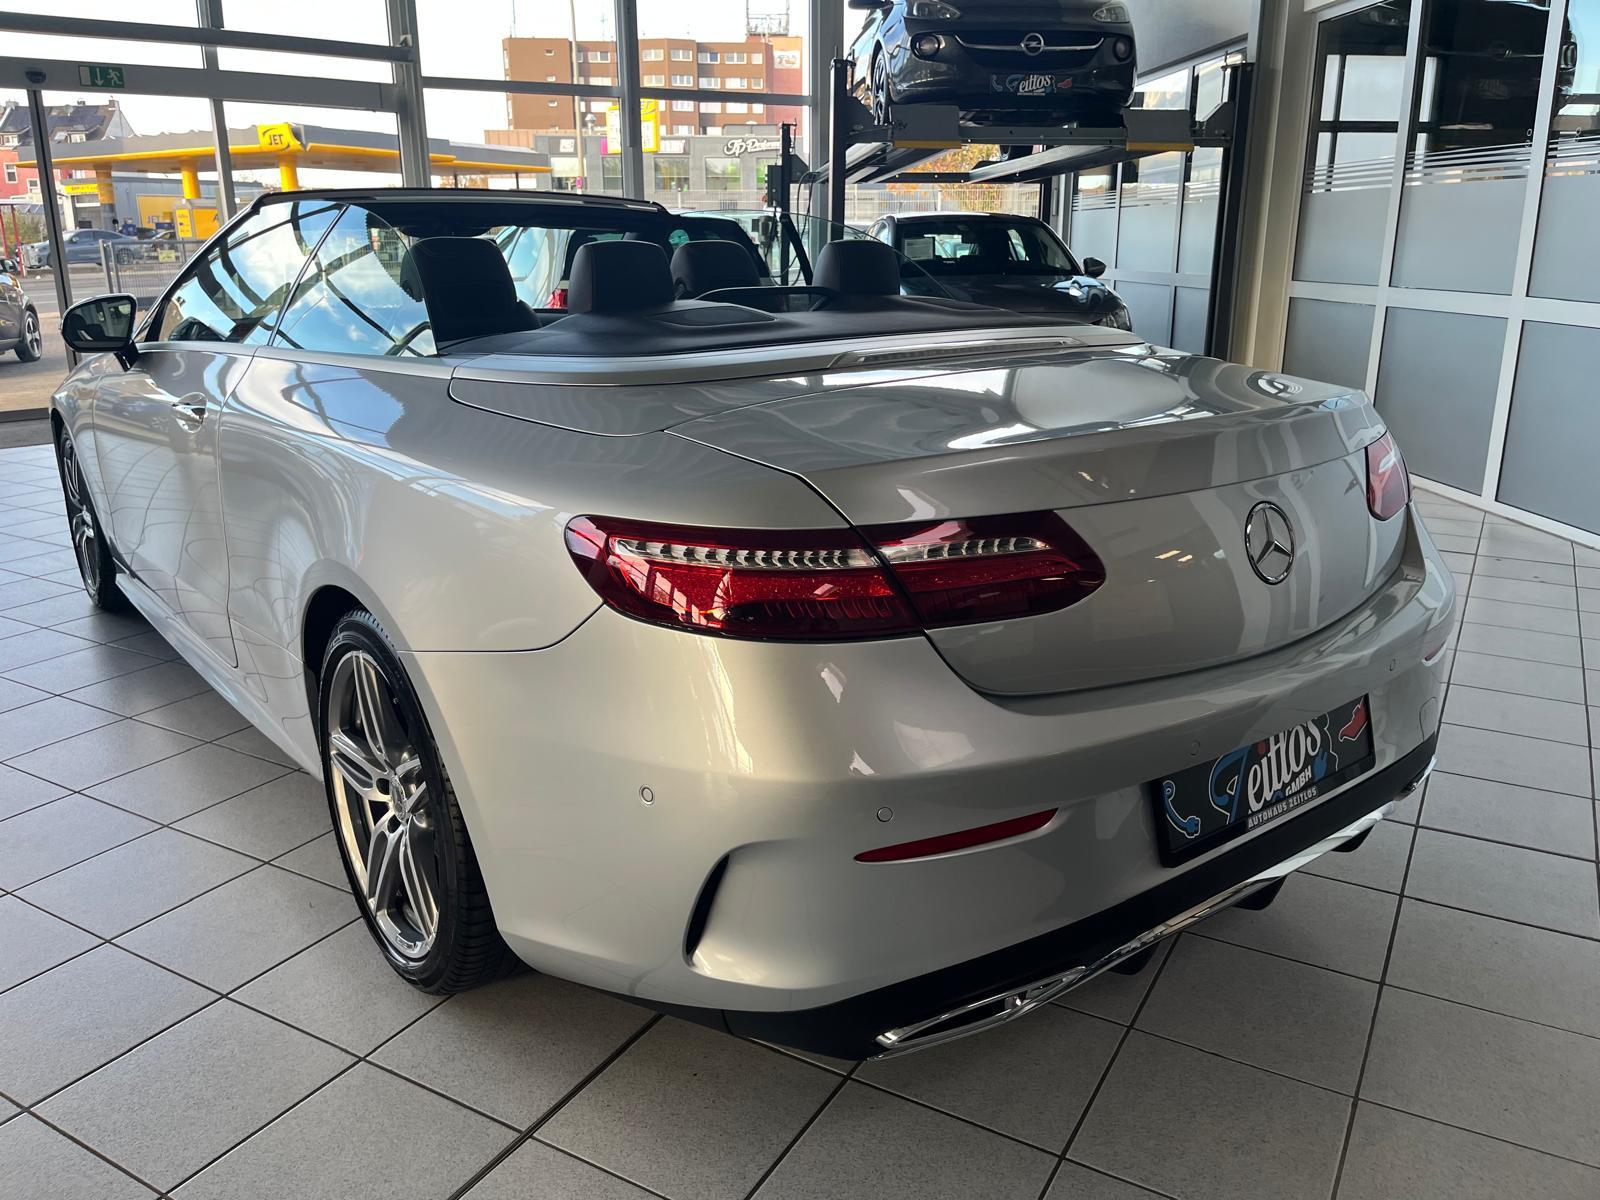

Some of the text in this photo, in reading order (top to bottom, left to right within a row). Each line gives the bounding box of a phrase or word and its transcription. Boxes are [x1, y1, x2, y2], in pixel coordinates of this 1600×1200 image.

[269, 134, 283, 146] JET
[1248, 785, 1318, 829] AUTOHAUS ZEITLOS
